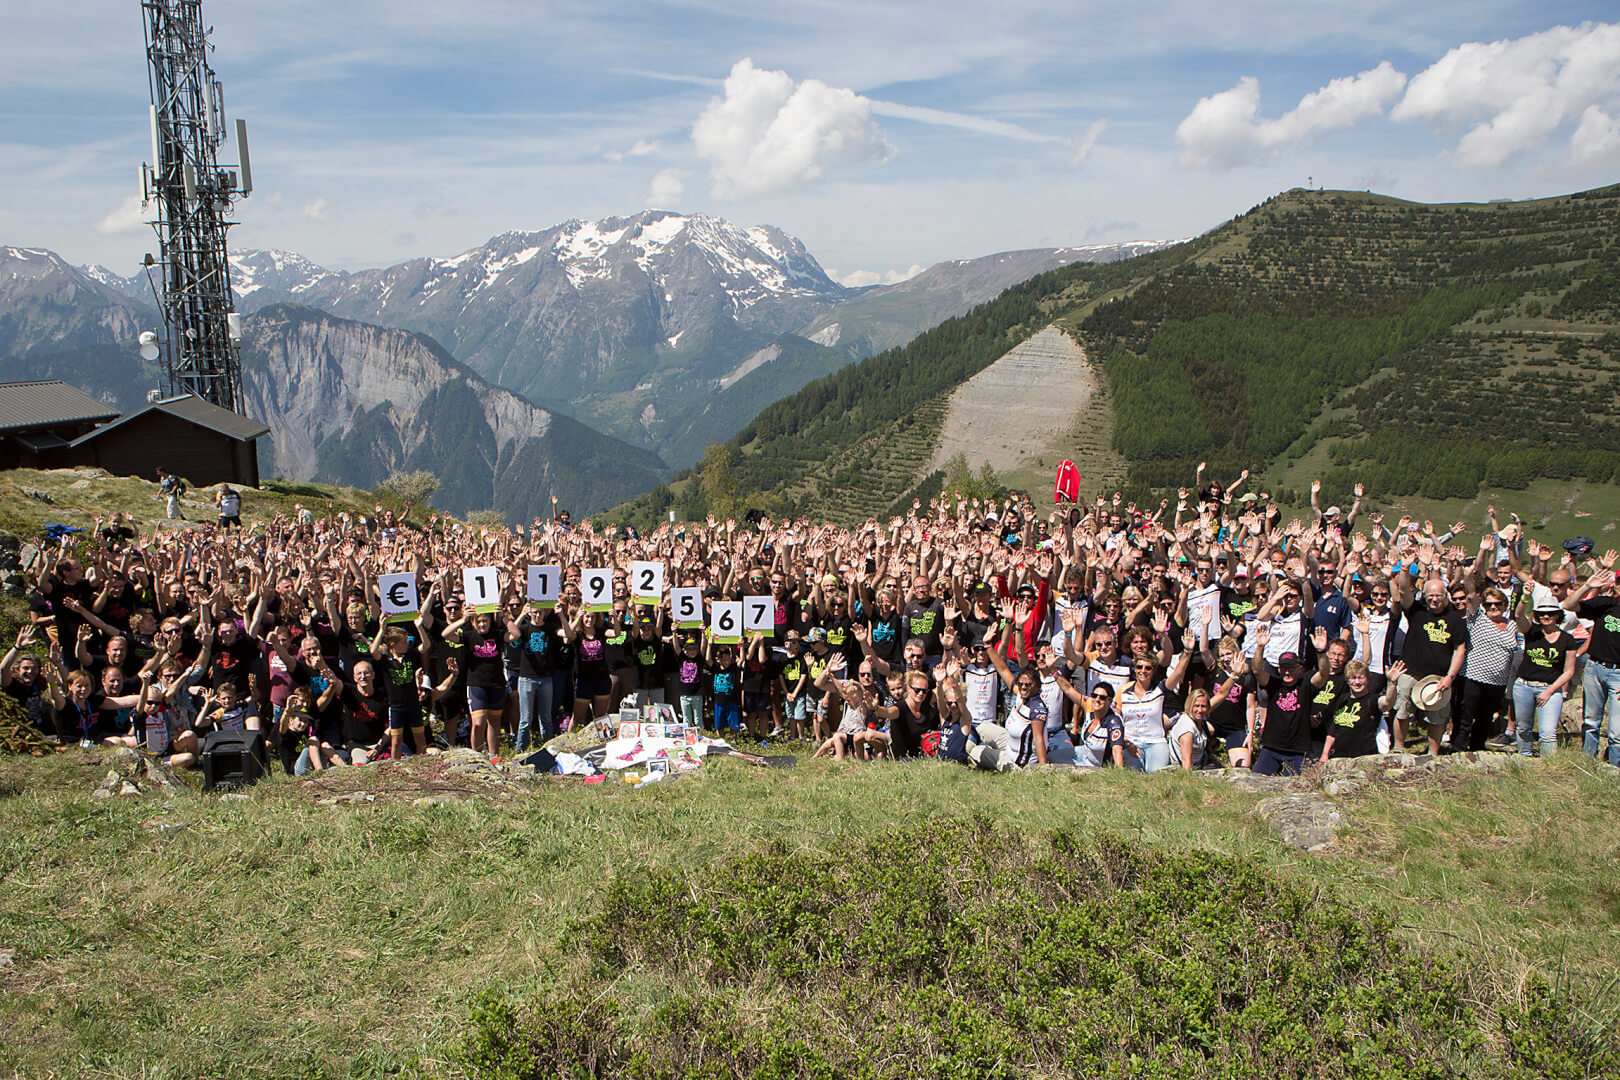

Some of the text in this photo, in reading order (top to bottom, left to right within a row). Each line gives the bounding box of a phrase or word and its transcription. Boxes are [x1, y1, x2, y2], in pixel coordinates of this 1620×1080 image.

[475, 576, 487, 599] 1
[538, 574, 548, 596] 1
[590, 577, 605, 599] 9
[640, 569, 655, 591] 2
[386, 582, 411, 607] €
[680, 596, 695, 617] 5
[752, 604, 767, 625] 7
[719, 610, 735, 631] 6
